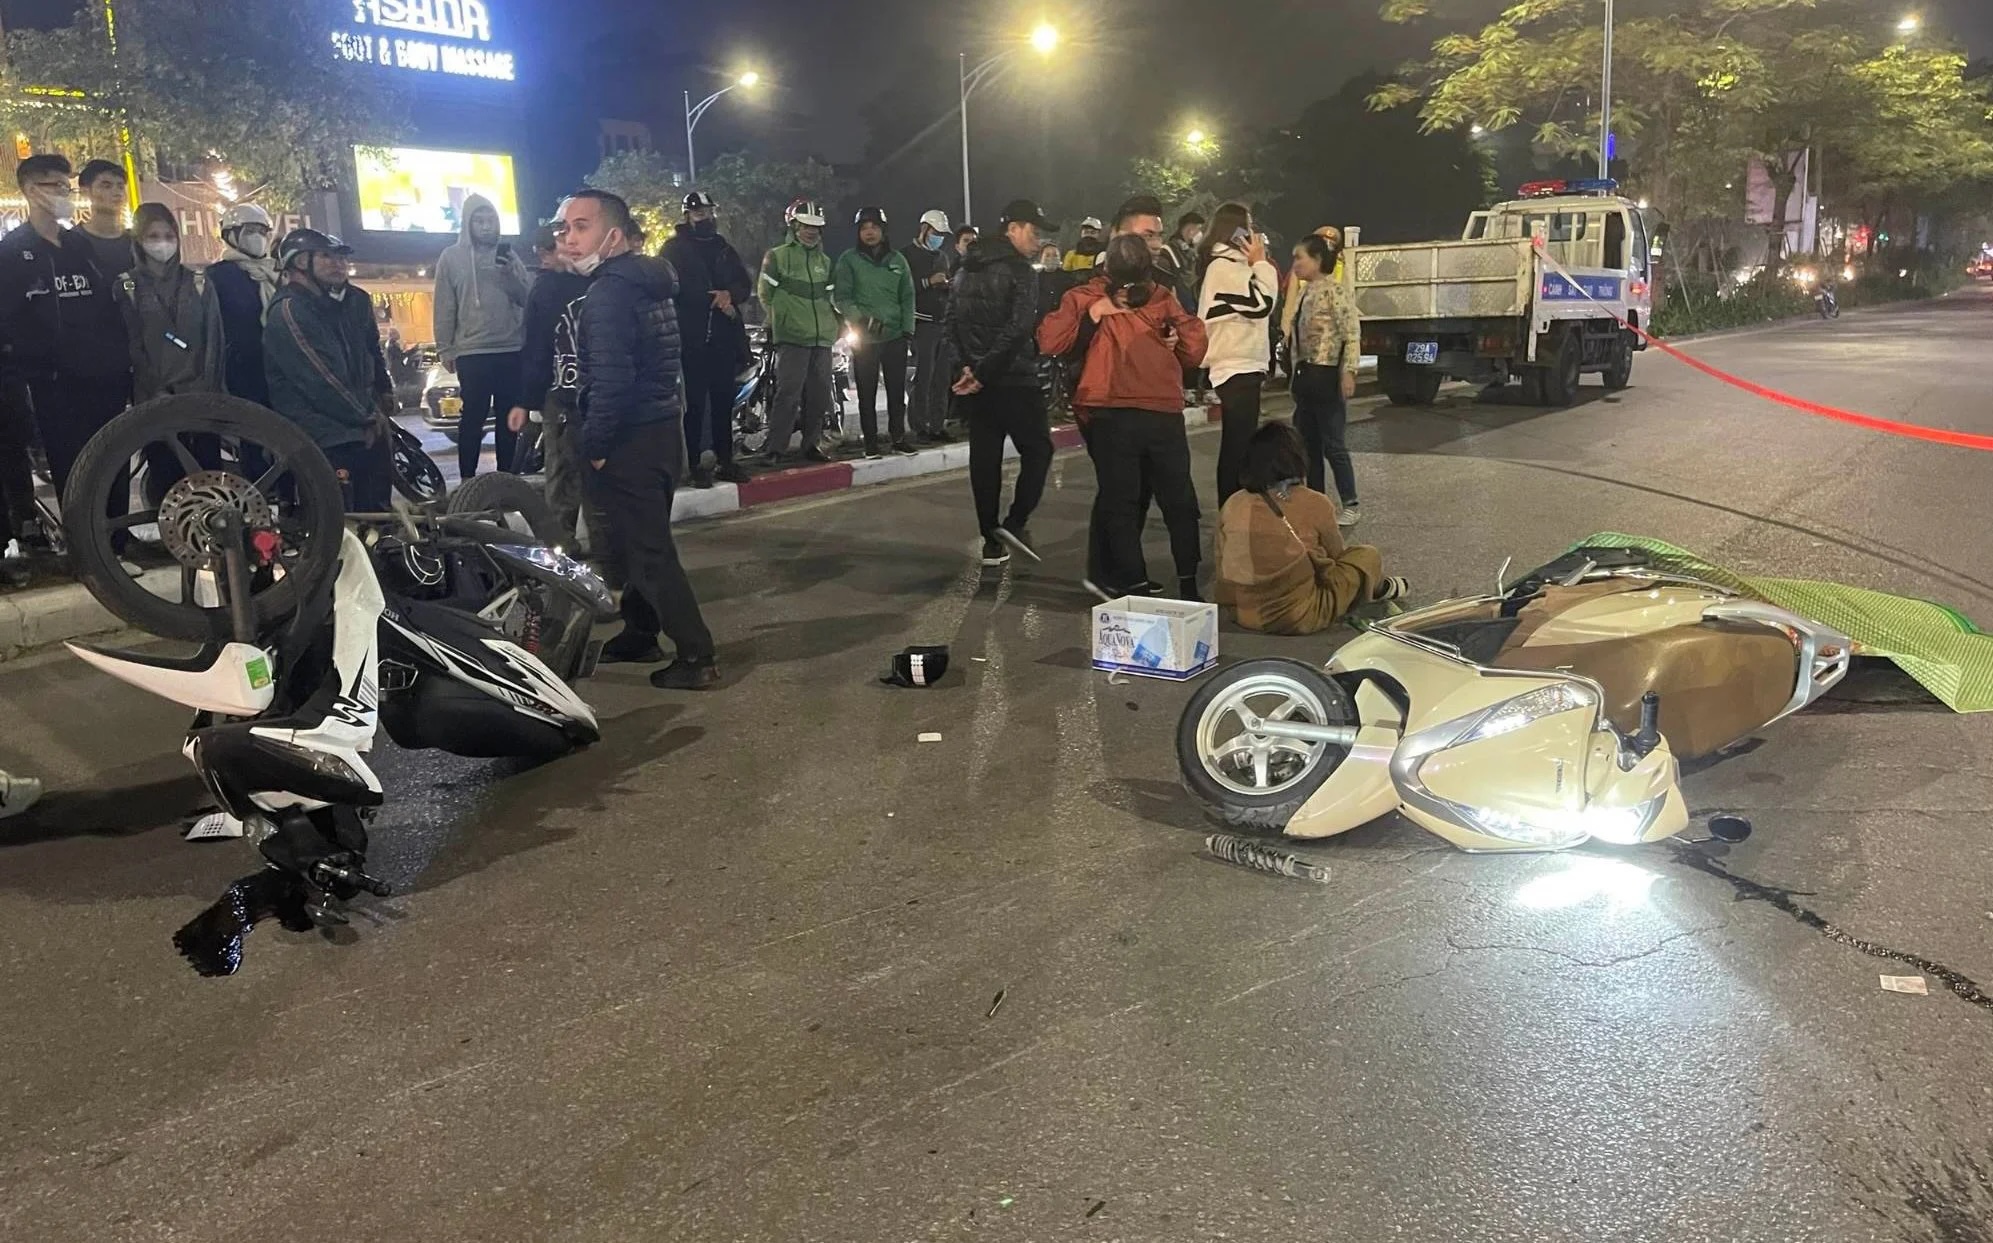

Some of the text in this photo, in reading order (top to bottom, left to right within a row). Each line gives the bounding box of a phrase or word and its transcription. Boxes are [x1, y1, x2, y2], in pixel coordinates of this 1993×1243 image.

[378, 37, 392, 66] &
[395, 39, 438, 72] BODY
[441, 45, 516, 81] MASSAGE
